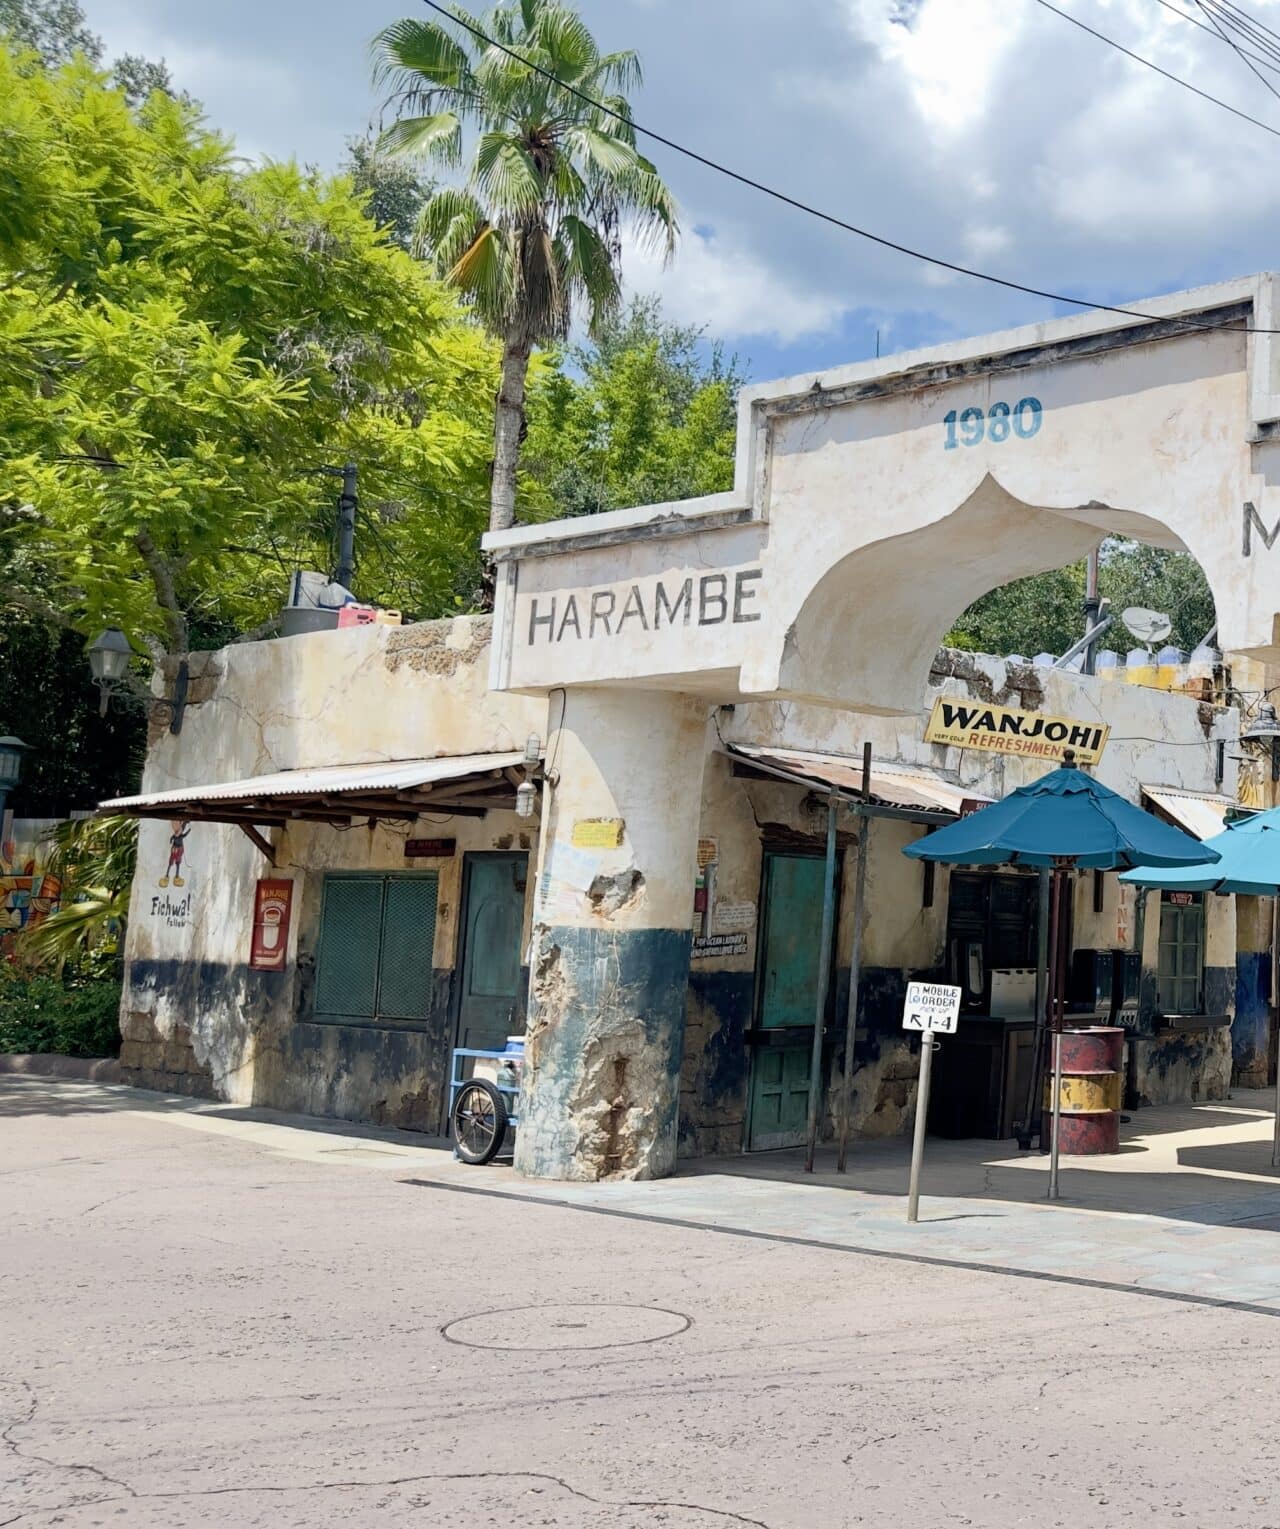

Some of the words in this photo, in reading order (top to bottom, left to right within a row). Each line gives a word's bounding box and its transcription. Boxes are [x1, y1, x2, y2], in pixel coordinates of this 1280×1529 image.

[943, 396, 1043, 451] 1980
[528, 567, 763, 646] HARAMBE
[941, 703, 1103, 751] WANJOHI
[968, 732, 1068, 758] REFRESHMENT
[922, 995, 955, 1008] ORDER
[923, 986, 957, 998] MOBILE
[928, 1015, 951, 1030] 1-4
